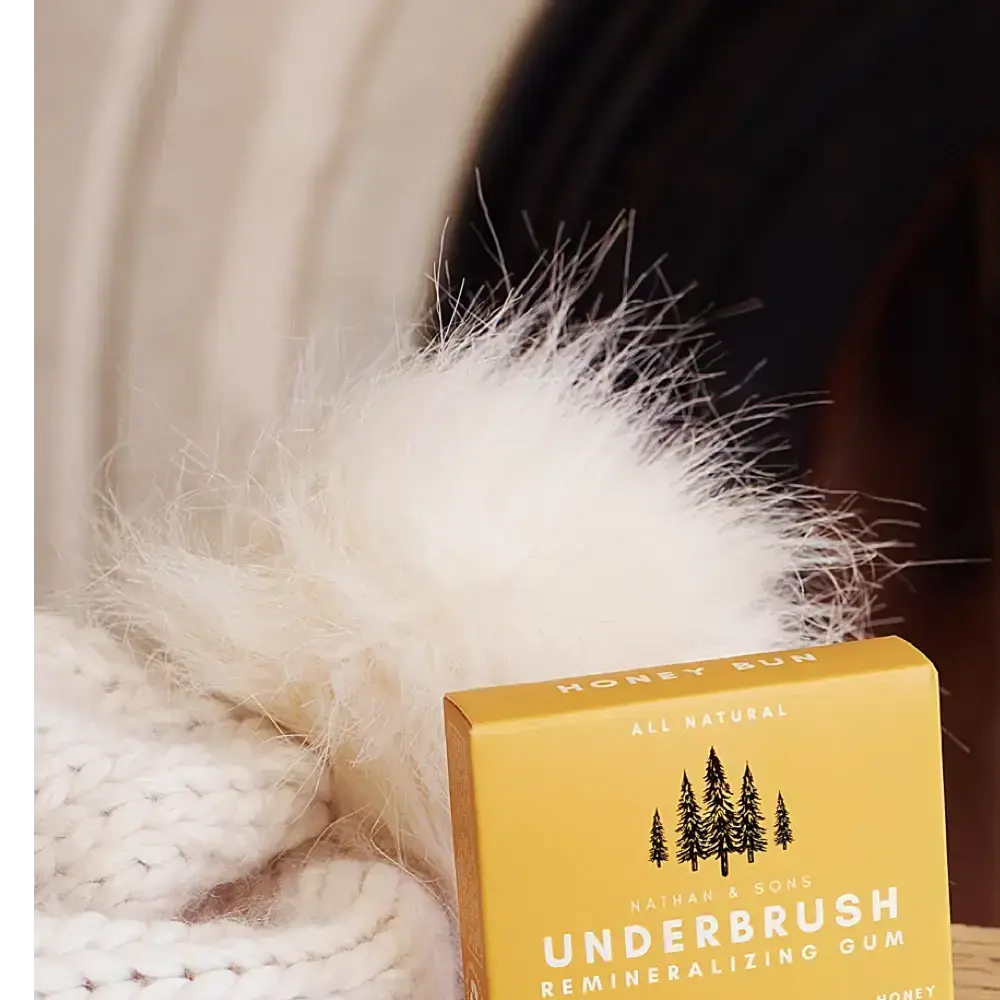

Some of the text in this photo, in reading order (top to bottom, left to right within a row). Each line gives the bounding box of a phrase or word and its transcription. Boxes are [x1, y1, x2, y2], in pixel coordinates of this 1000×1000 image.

[556, 653, 818, 694] HONEY BUN
[631, 704, 788, 736] ALL NATURAL
[630, 875, 813, 912] NATHAN & SONS
[542, 886, 899, 969] UNDERBRUSH
[540, 929, 906, 999] REMINERALIZING GUM
